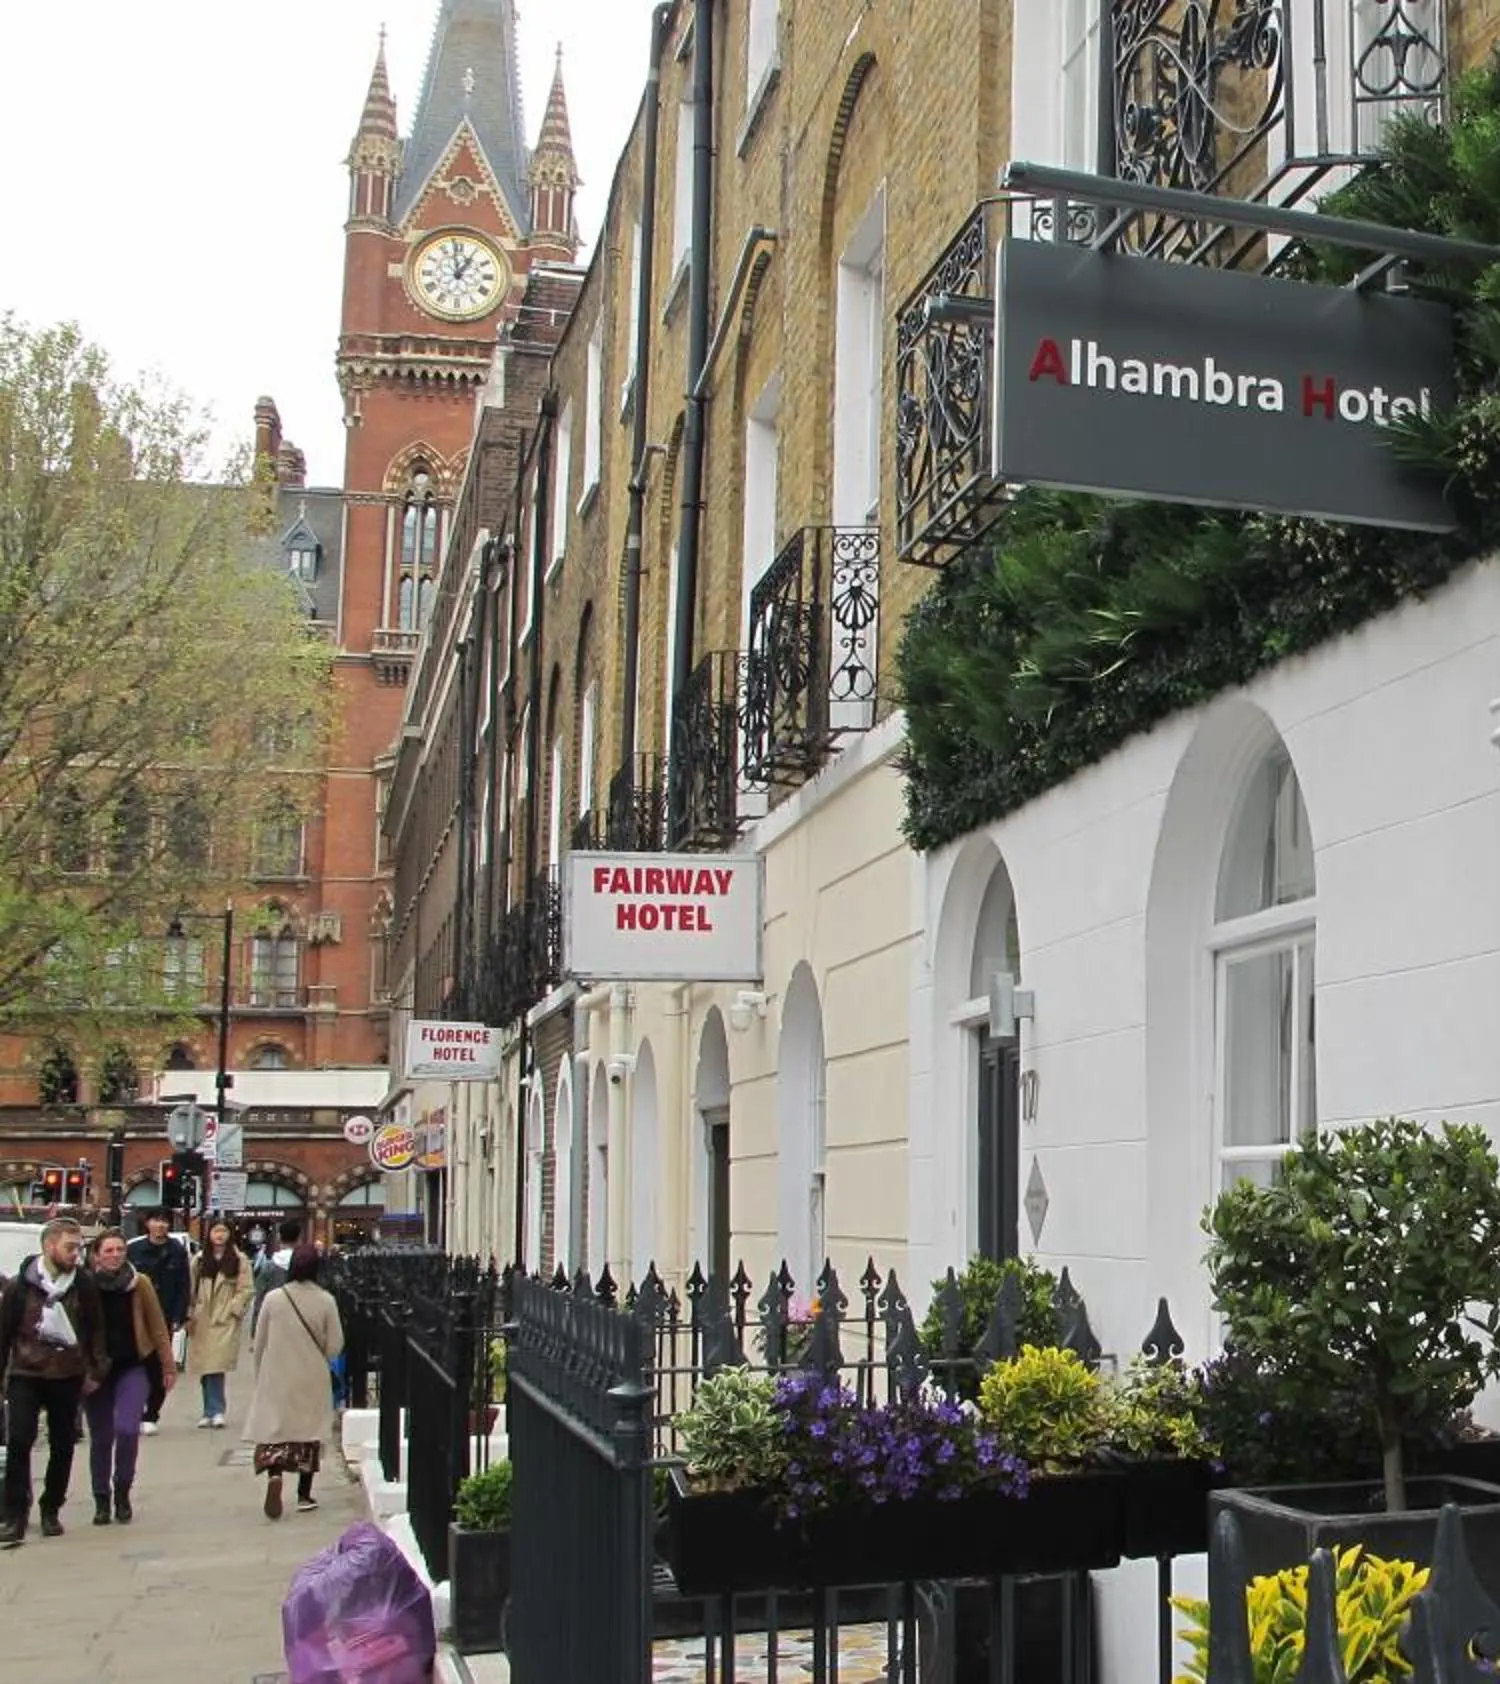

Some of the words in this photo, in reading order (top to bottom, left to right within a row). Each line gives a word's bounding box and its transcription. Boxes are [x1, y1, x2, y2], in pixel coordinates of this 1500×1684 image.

[1029, 338, 1284, 411] Alhambra
[593, 867, 733, 896] FAIRWAY
[616, 904, 713, 931] HOTEL
[422, 1027, 491, 1044] FLORENCE
[433, 1047, 476, 1062] HOTEL
[378, 1140, 415, 1160] KING
